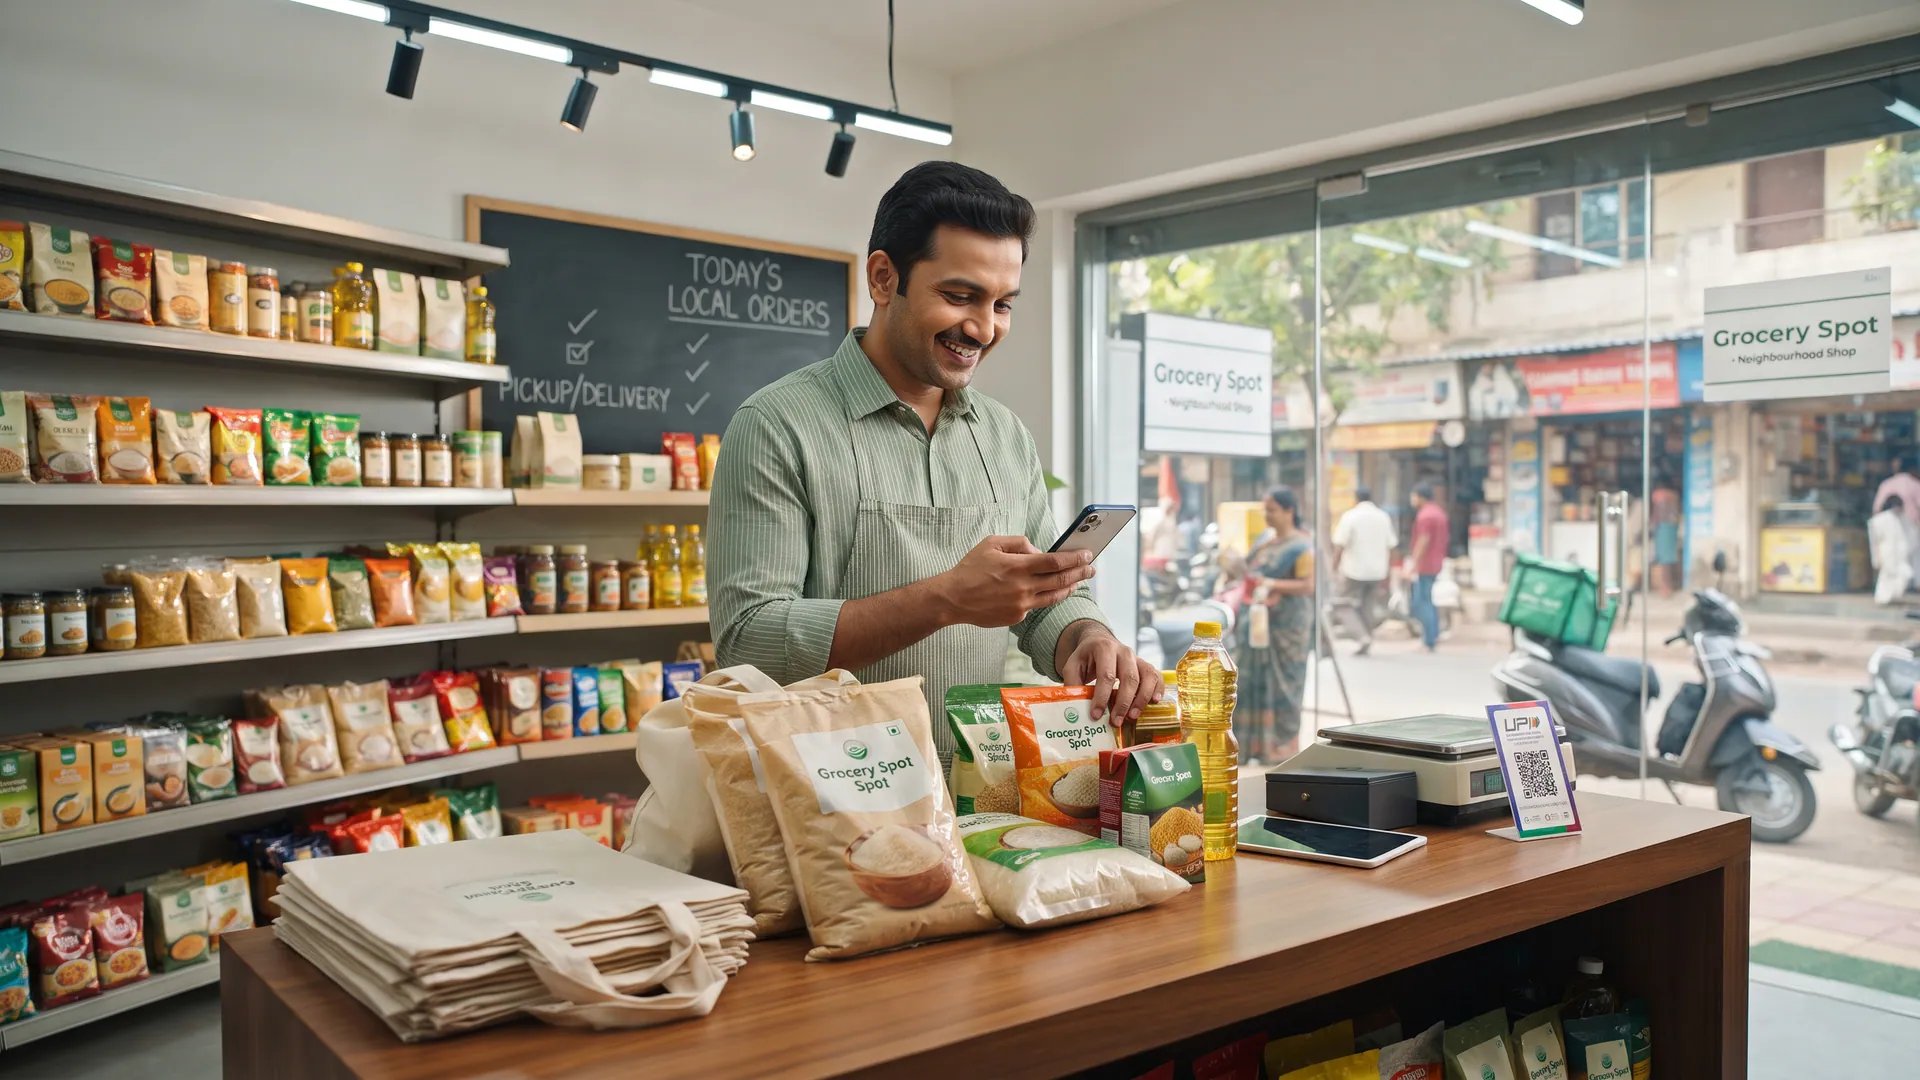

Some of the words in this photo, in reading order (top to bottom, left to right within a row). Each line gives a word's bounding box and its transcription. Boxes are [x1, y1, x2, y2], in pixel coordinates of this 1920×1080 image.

[685, 252, 784, 293] TODAY'S
[667, 284, 740, 320] LOCAL
[747, 293, 832, 330] ORDERS
[1713, 324, 1810, 348] Grocery
[1817, 316, 1879, 342] Spot
[1738, 350, 1825, 366] Neighbourhood
[1826, 347, 1857, 360] Shop
[1154, 362, 1222, 393] Grocery
[1227, 369, 1263, 394] Spot
[499, 372, 671, 414] PICKUP/DELIVERY
[1045, 728, 1083, 741] Grocery
[1504, 716, 1532, 732] UPI
[1068, 737, 1092, 751] Spot
[817, 765, 875, 780] Grocery
[878, 756, 914, 776] Spot
[854, 777, 891, 794] Spot
